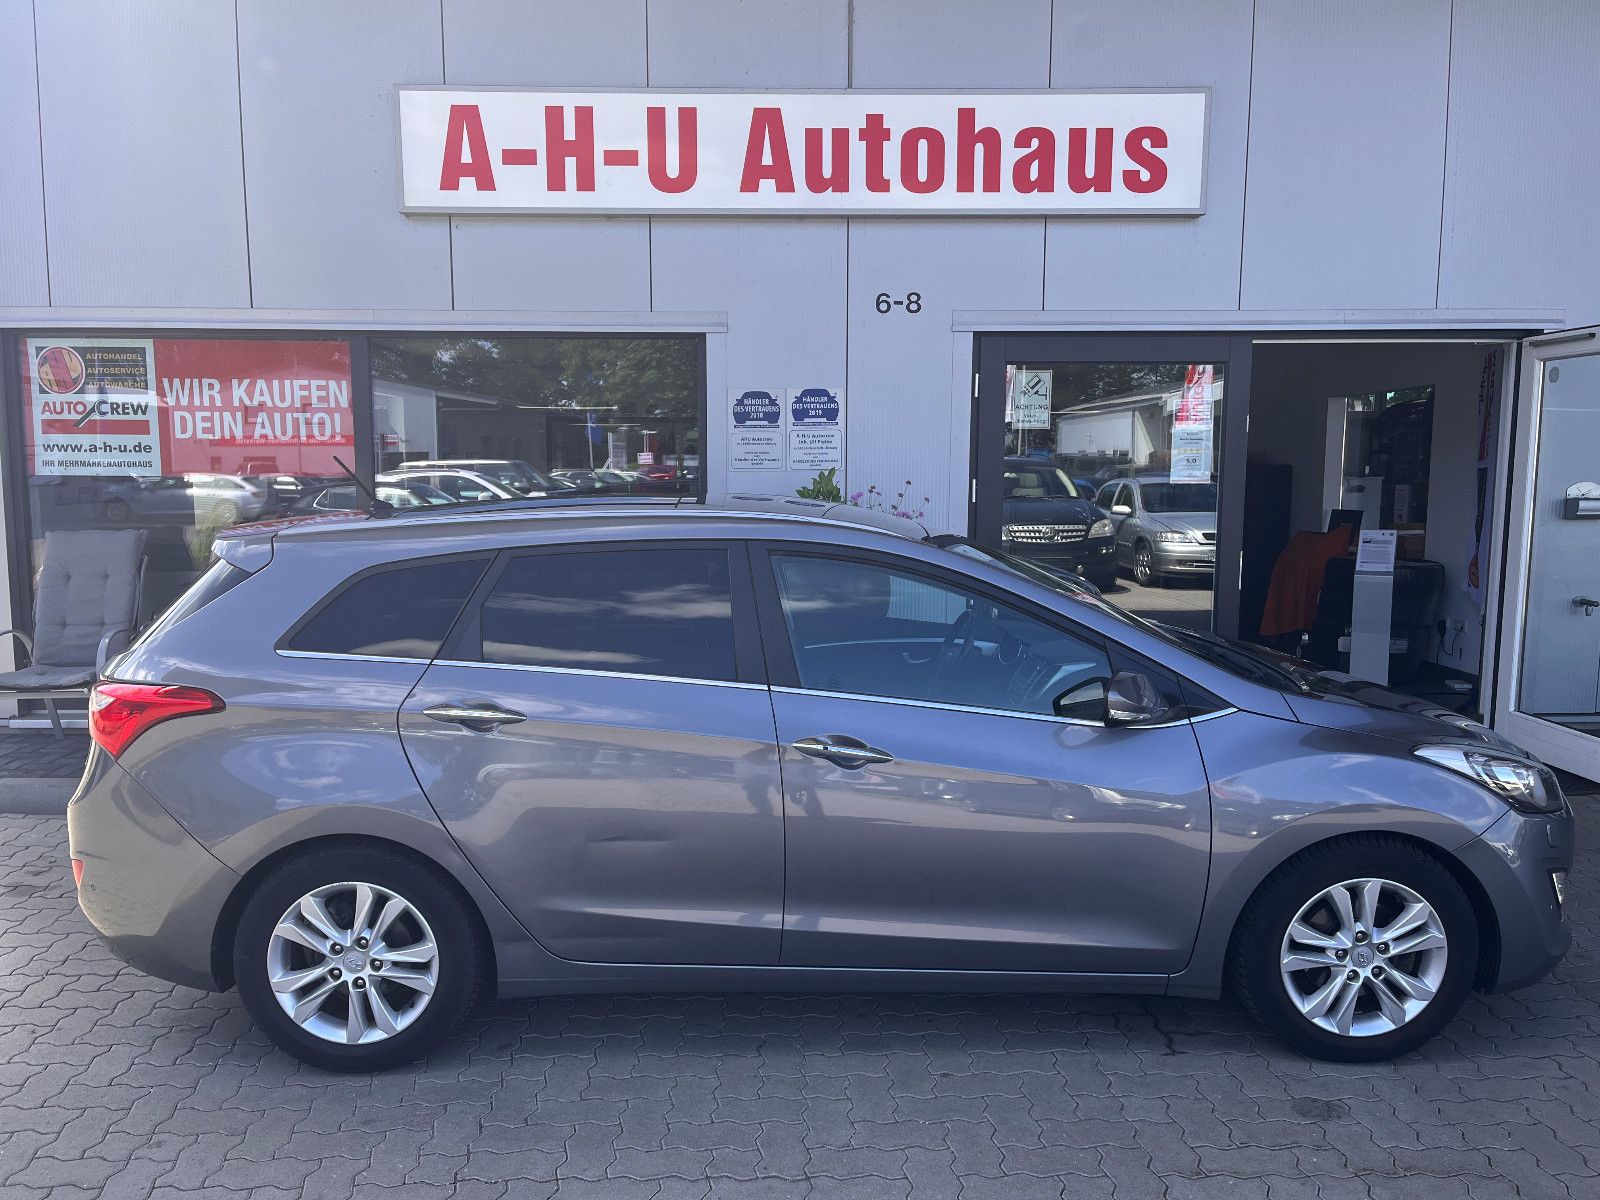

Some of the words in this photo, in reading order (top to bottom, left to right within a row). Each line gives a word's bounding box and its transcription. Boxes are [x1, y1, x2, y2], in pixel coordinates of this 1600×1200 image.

[439, 103, 698, 194] A-H-U
[739, 107, 1169, 194] Autohaus
[875, 291, 922, 314] 6-8
[162, 378, 222, 407] WIR
[231, 379, 348, 408] KAUFEN
[41, 401, 88, 415] AUTO
[95, 400, 148, 417] CREW
[173, 411, 243, 440] DEIN
[253, 412, 342, 441] AUTO!
[43, 441, 153, 454] www.a-h-u.de
[42, 460, 55, 468] IHR
[58, 460, 153, 468] MEHRMARKENAUTOHAUS
[1185, 458, 1197, 466] 5,0
